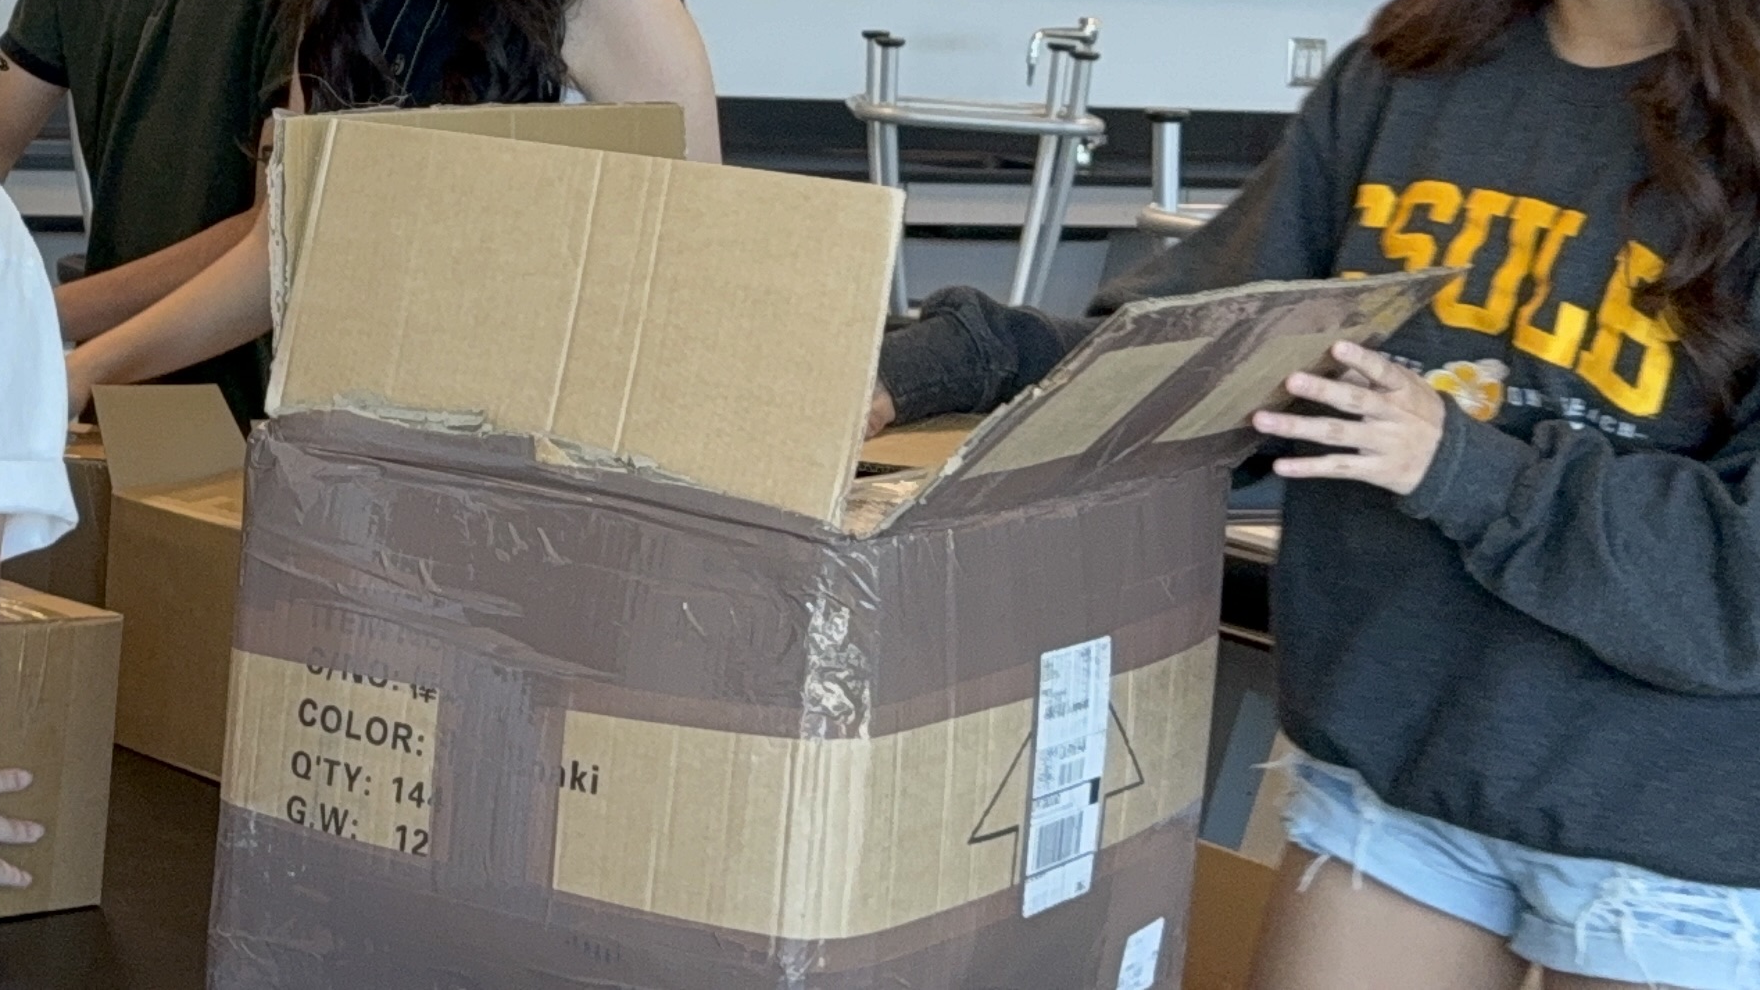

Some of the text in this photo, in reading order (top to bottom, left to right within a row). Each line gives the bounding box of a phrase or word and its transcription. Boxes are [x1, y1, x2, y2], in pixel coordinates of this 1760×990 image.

[297, 697, 425, 757] COLOR:
[291, 750, 441, 809] Q'TY: 14
[395, 824, 430, 857] 12
